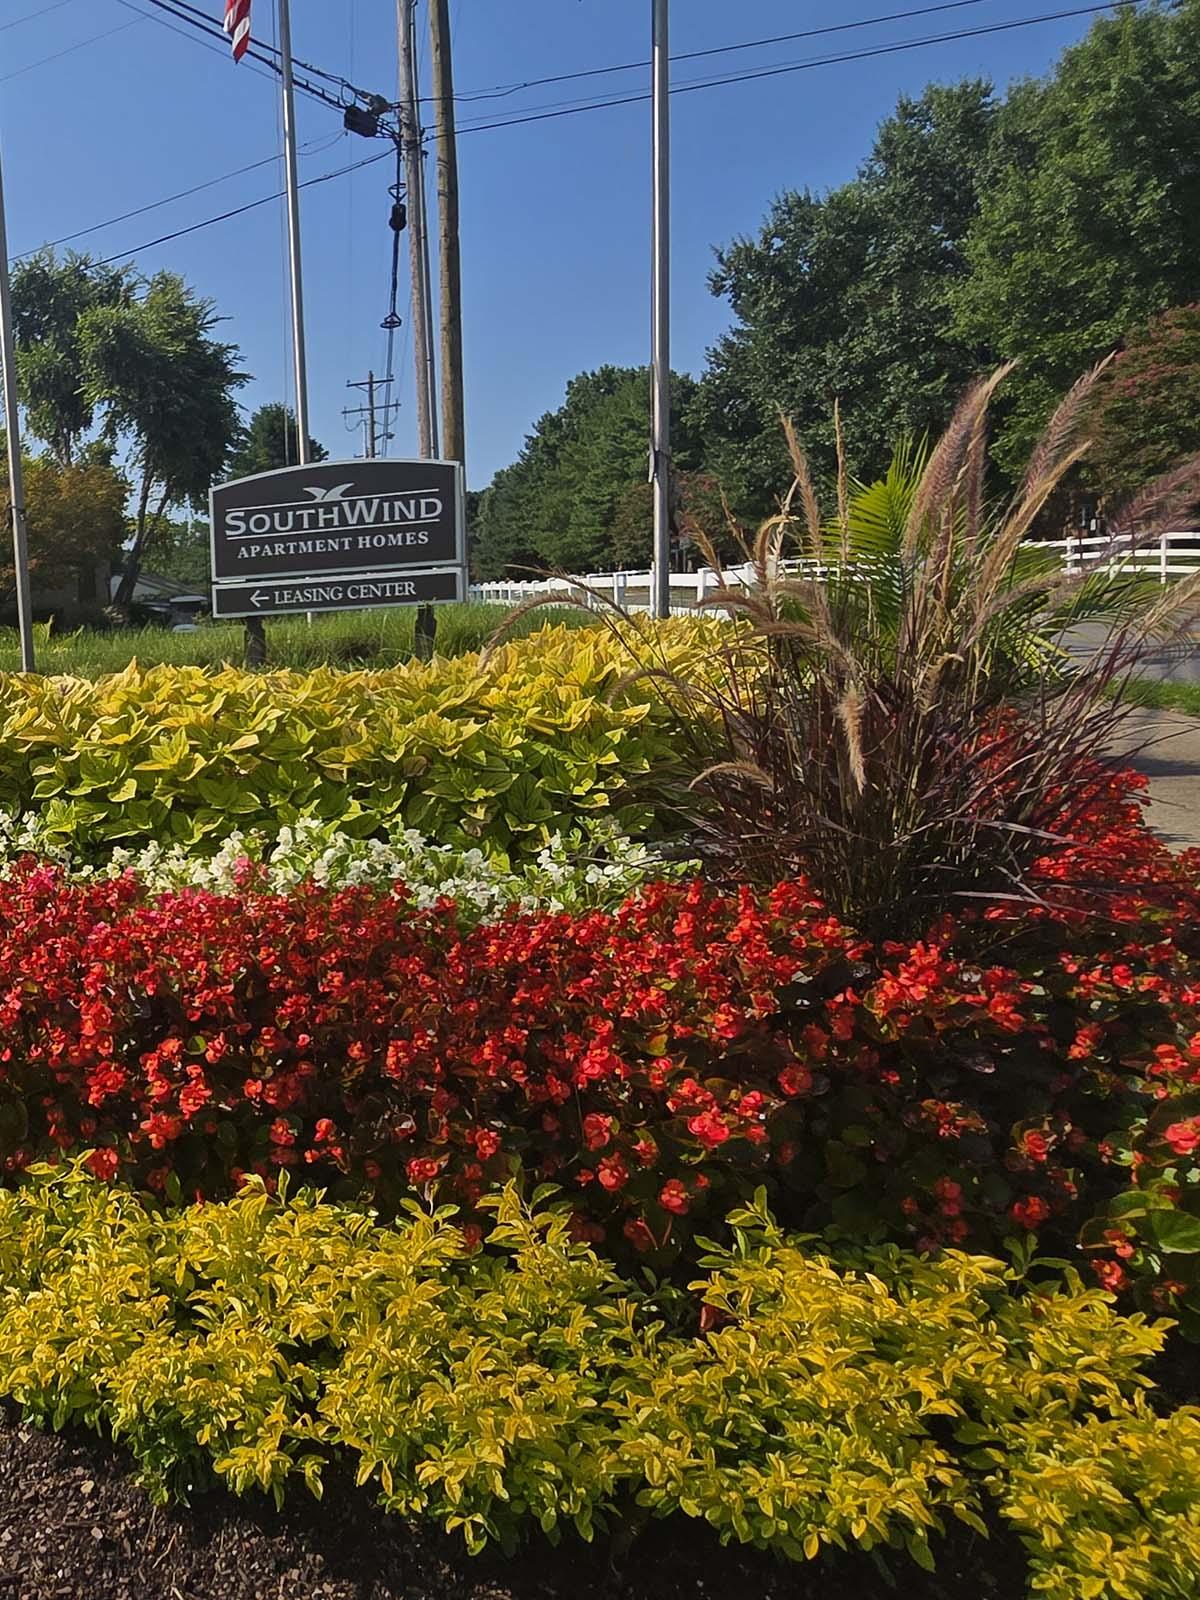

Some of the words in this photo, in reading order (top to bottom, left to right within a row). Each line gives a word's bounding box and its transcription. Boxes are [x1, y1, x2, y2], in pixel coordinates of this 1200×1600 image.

[224, 498, 442, 536] SOUTHWIND
[237, 537, 352, 559] APARTMENT
[358, 531, 429, 549] HOMES
[274, 586, 343, 604] LEASING
[347, 581, 417, 600] CENTER
